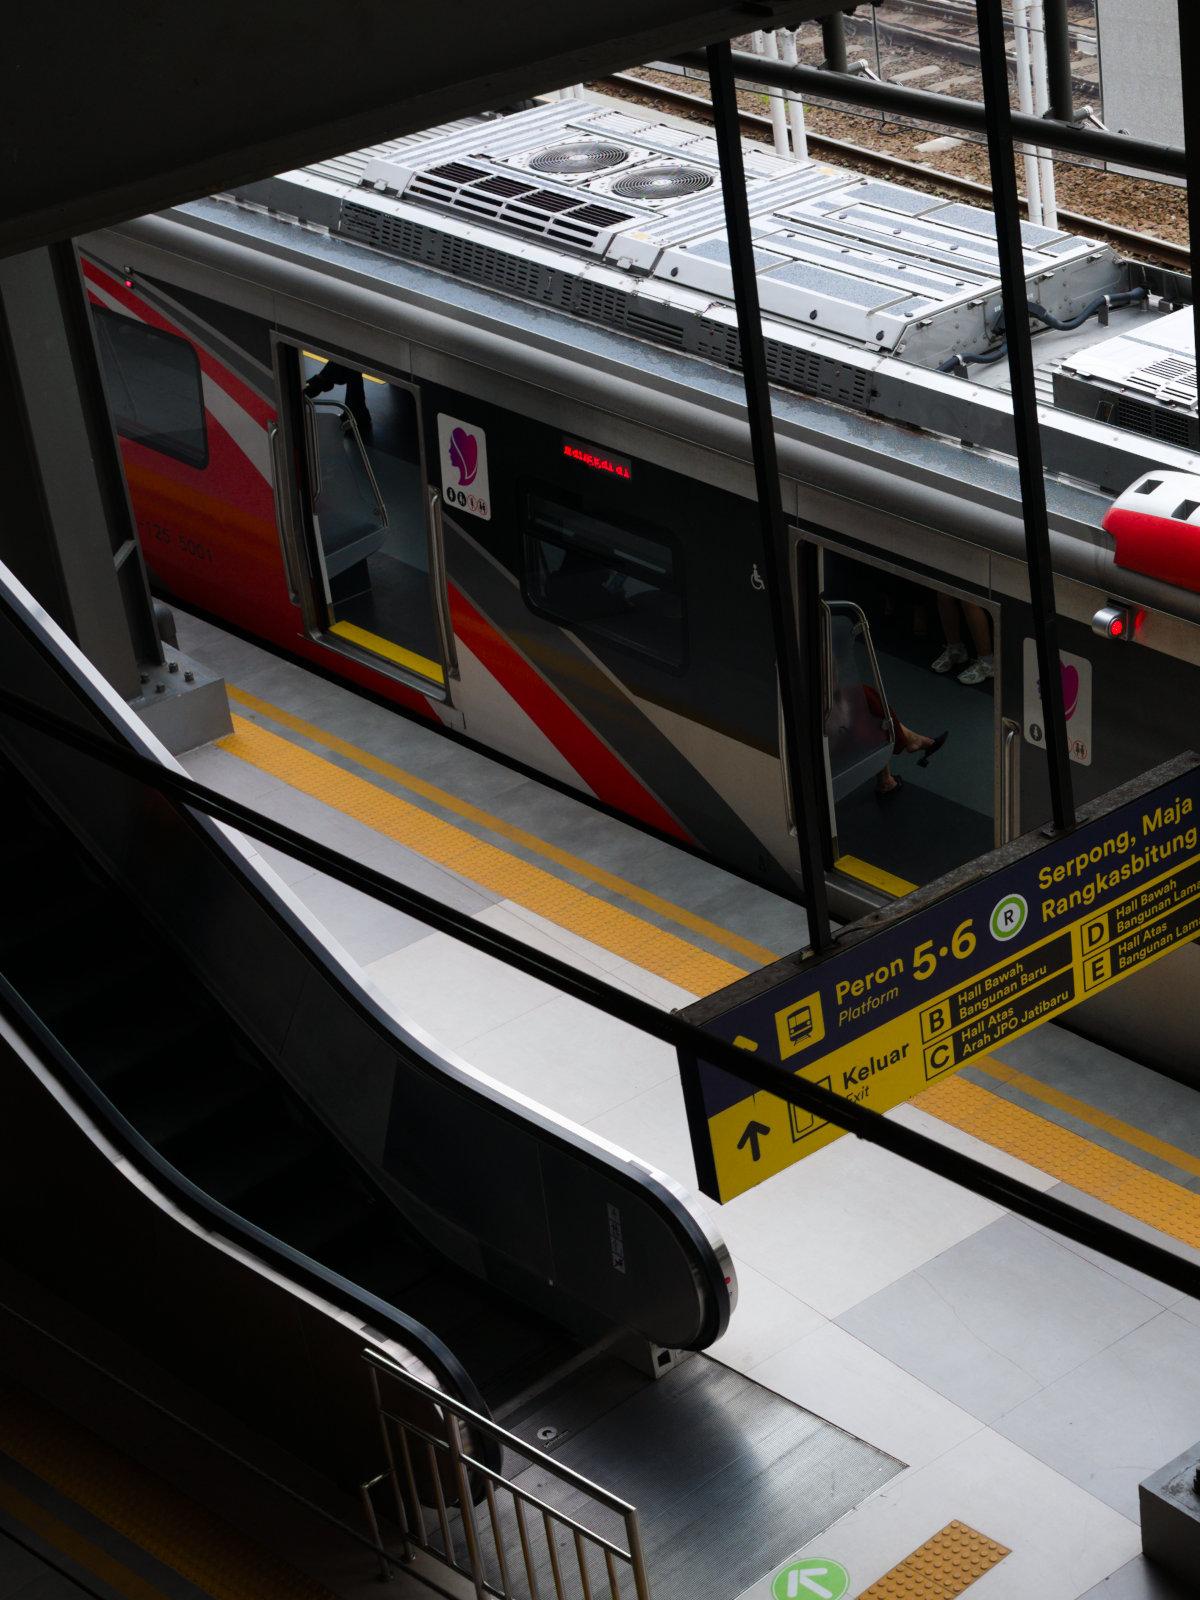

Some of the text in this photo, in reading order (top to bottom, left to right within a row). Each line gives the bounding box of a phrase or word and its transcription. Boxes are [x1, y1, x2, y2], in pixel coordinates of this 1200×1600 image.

[1038, 797, 1193, 890] Serpong, Maja
[1041, 827, 1198, 923] Rangkasbitung
[1003, 909, 1014, 926] R
[1116, 879, 1177, 920] Hall Bawah
[1117, 898, 1171, 933] Bangunan
[1088, 922, 1104, 947] D
[1118, 921, 1168, 955] Hall Atas
[1119, 934, 1173, 969] Bangunan
[835, 958, 904, 1006] Peron
[958, 962, 1024, 1006] Hall Bawah
[1092, 957, 1105, 981] E
[838, 986, 899, 1027] Platform
[959, 965, 1047, 1020] Bangunan Baru
[929, 1008, 945, 1034] B
[961, 1006, 1014, 1042] Hall Atas
[962, 990, 1069, 1056] Arah JPO Jatibaru
[842, 1042, 910, 1089] Keluar
[930, 1044, 949, 1069] C
